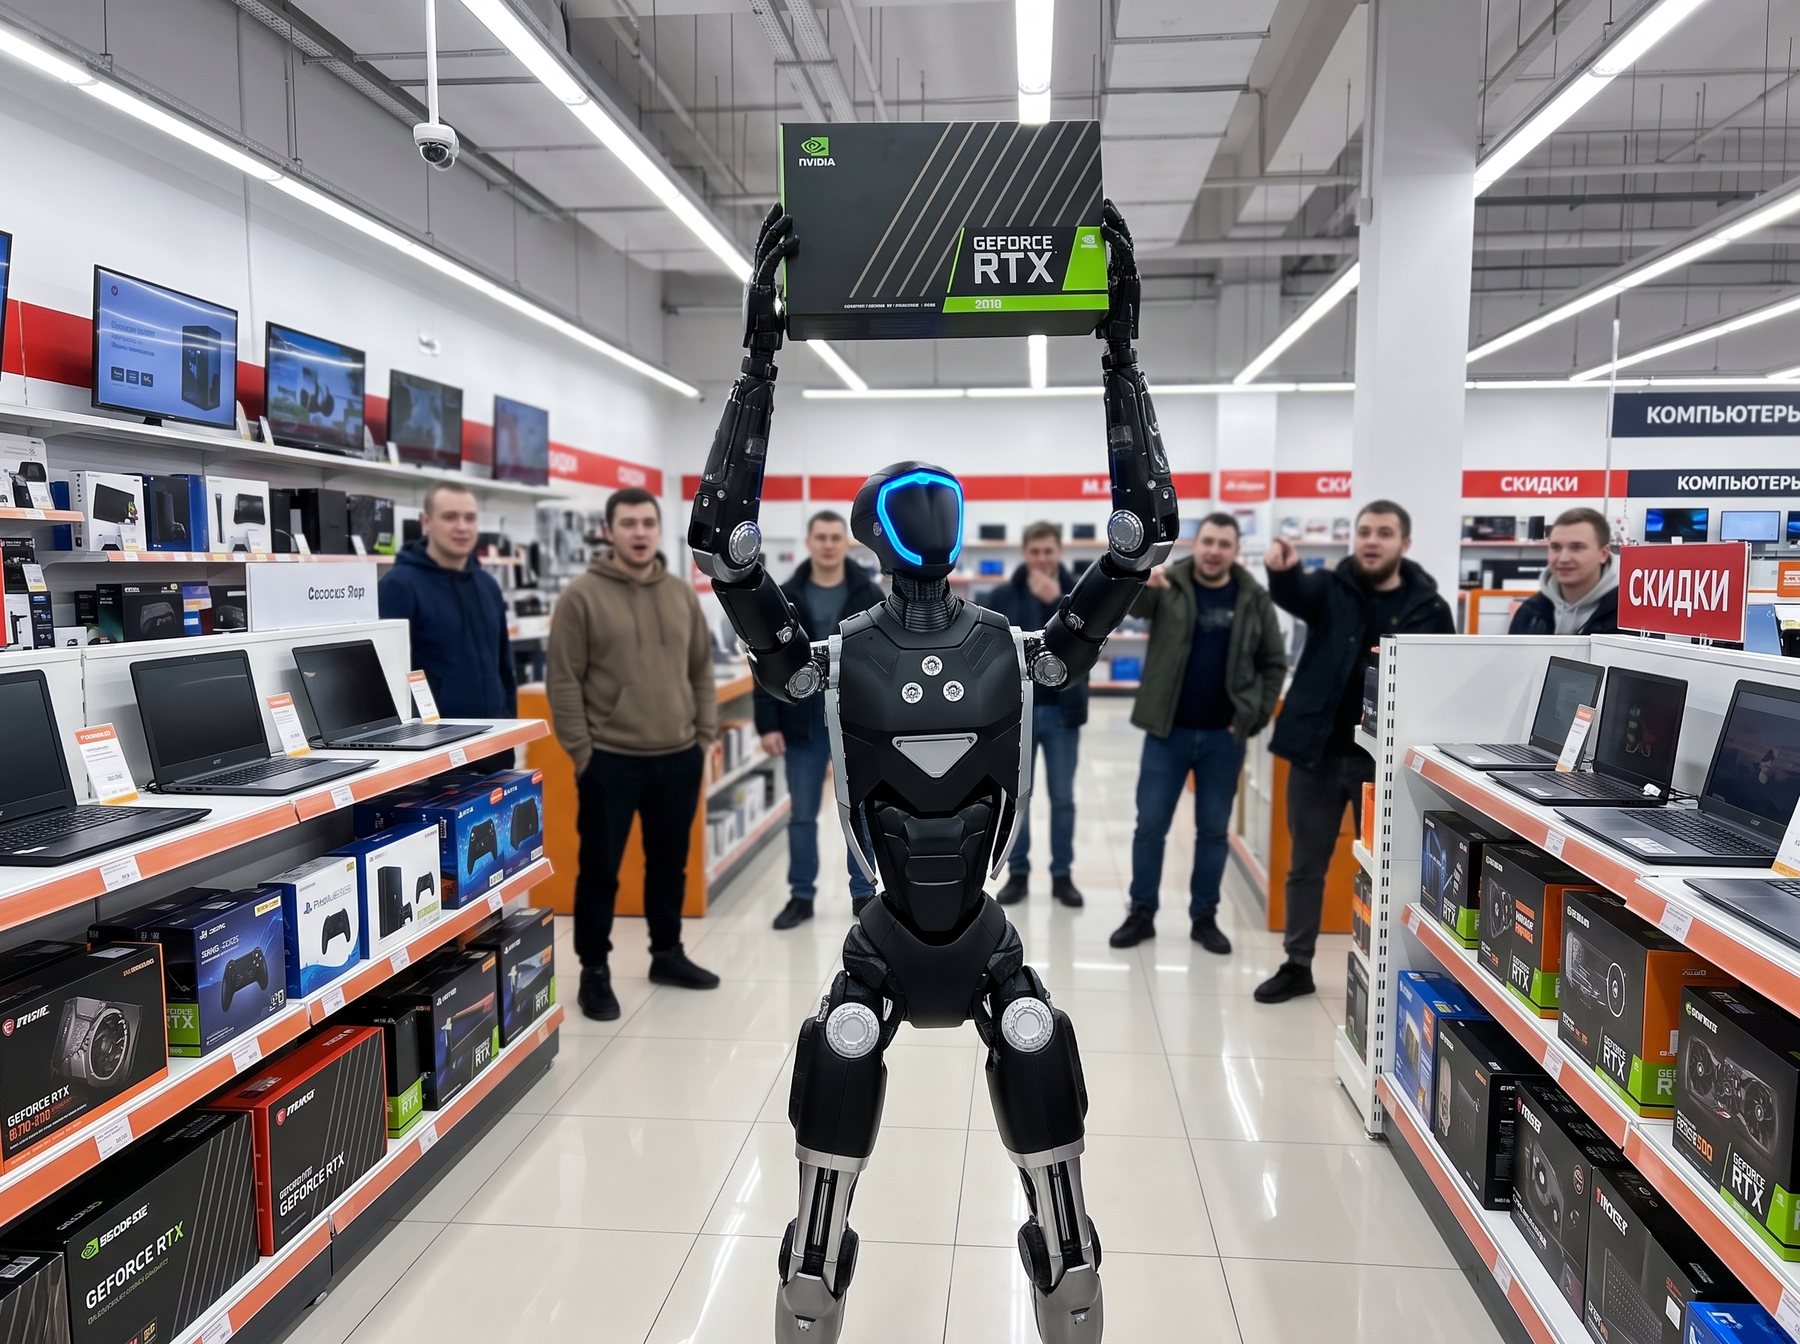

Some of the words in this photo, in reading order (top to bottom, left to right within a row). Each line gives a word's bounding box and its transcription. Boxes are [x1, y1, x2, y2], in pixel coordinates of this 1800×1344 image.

[973, 235, 1053, 250] GEFORCE
[973, 251, 1055, 284] RTX
[1501, 476, 1579, 495] СКИДКИ
[1629, 568, 1730, 618] СКИДКИ
[1511, 963, 1529, 992] RTX
[1603, 1044, 1626, 1082] RTX
[8, 1095, 51, 1128] GEFORCE
[51, 1084, 70, 1104] RTX
[279, 1167, 325, 1217] GEFORCE
[325, 1151, 345, 1179] RTX
[1731, 1163, 1764, 1216] RTX
[1733, 1152, 1766, 1191] GEFORCE
[85, 1244, 154, 1309] GEFORCE
[156, 1220, 185, 1256] RTX
